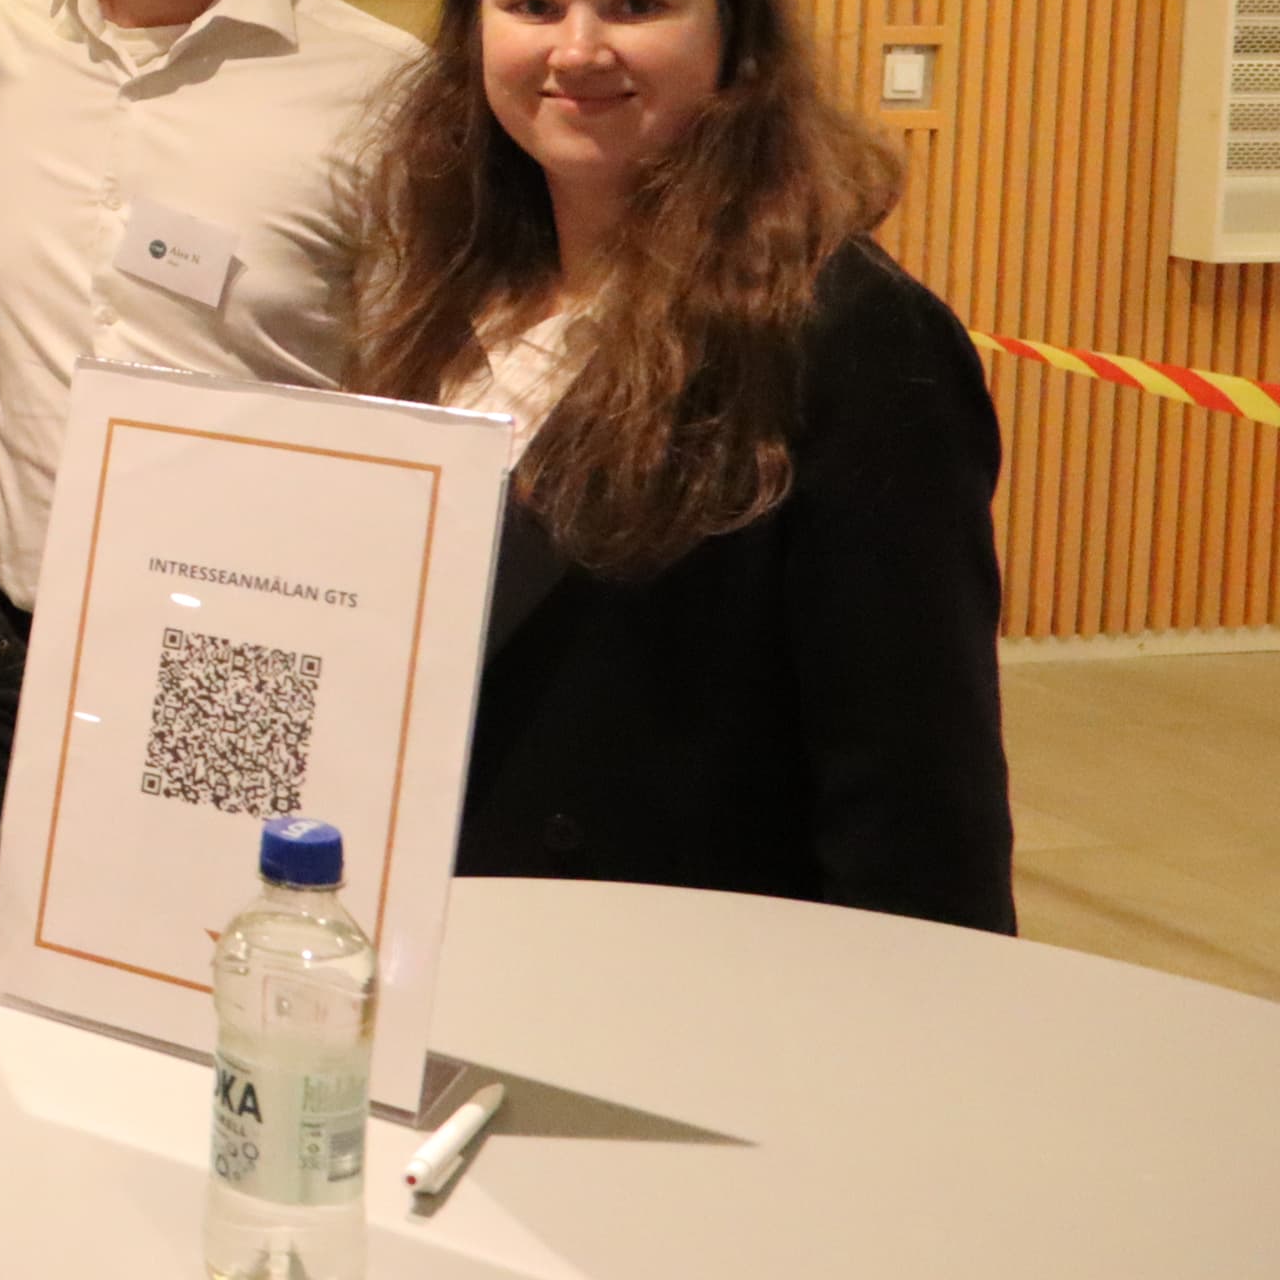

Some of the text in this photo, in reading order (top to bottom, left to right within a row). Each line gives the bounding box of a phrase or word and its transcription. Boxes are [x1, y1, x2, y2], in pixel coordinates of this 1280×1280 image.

[148, 557, 359, 608] INTRESSEANMÄLAN GTS
[214, 1070, 263, 1124] KA
